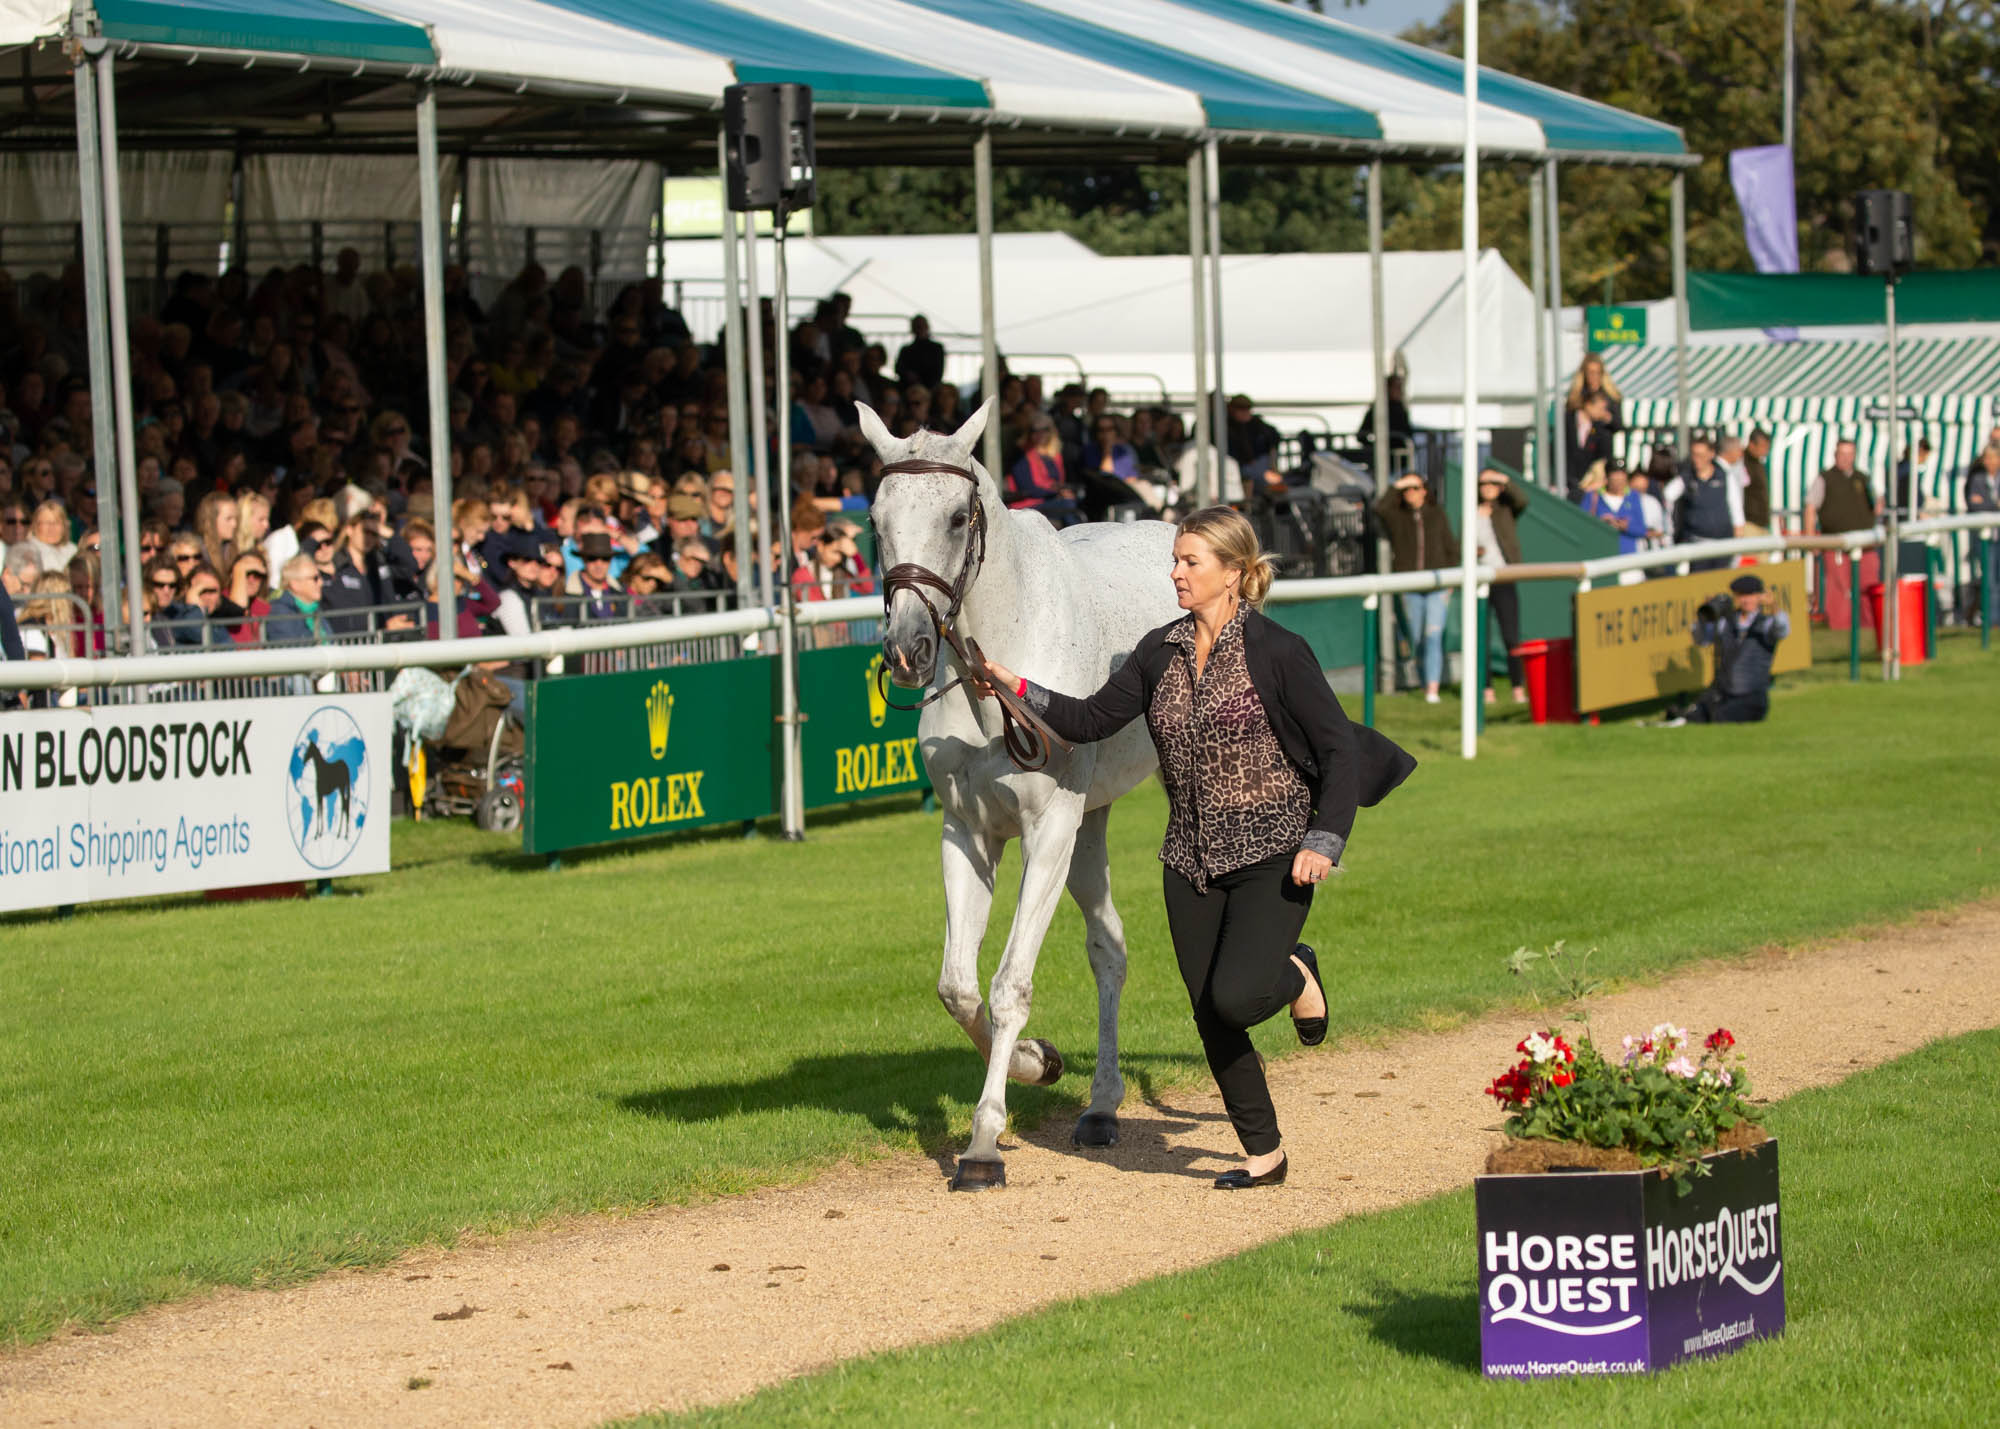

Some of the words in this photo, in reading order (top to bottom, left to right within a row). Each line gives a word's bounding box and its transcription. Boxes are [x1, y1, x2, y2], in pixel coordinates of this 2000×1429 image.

[1595, 608, 1624, 649] THE
[35, 720, 252, 788] BLOODSTOCK
[835, 737, 919, 793] ROLEX
[610, 770, 705, 830] ROLEX
[69, 819, 167, 876] Shipping
[174, 813, 250, 869] Agents
[1487, 1358, 1645, 1374] www.HorseQuest.co.uk
